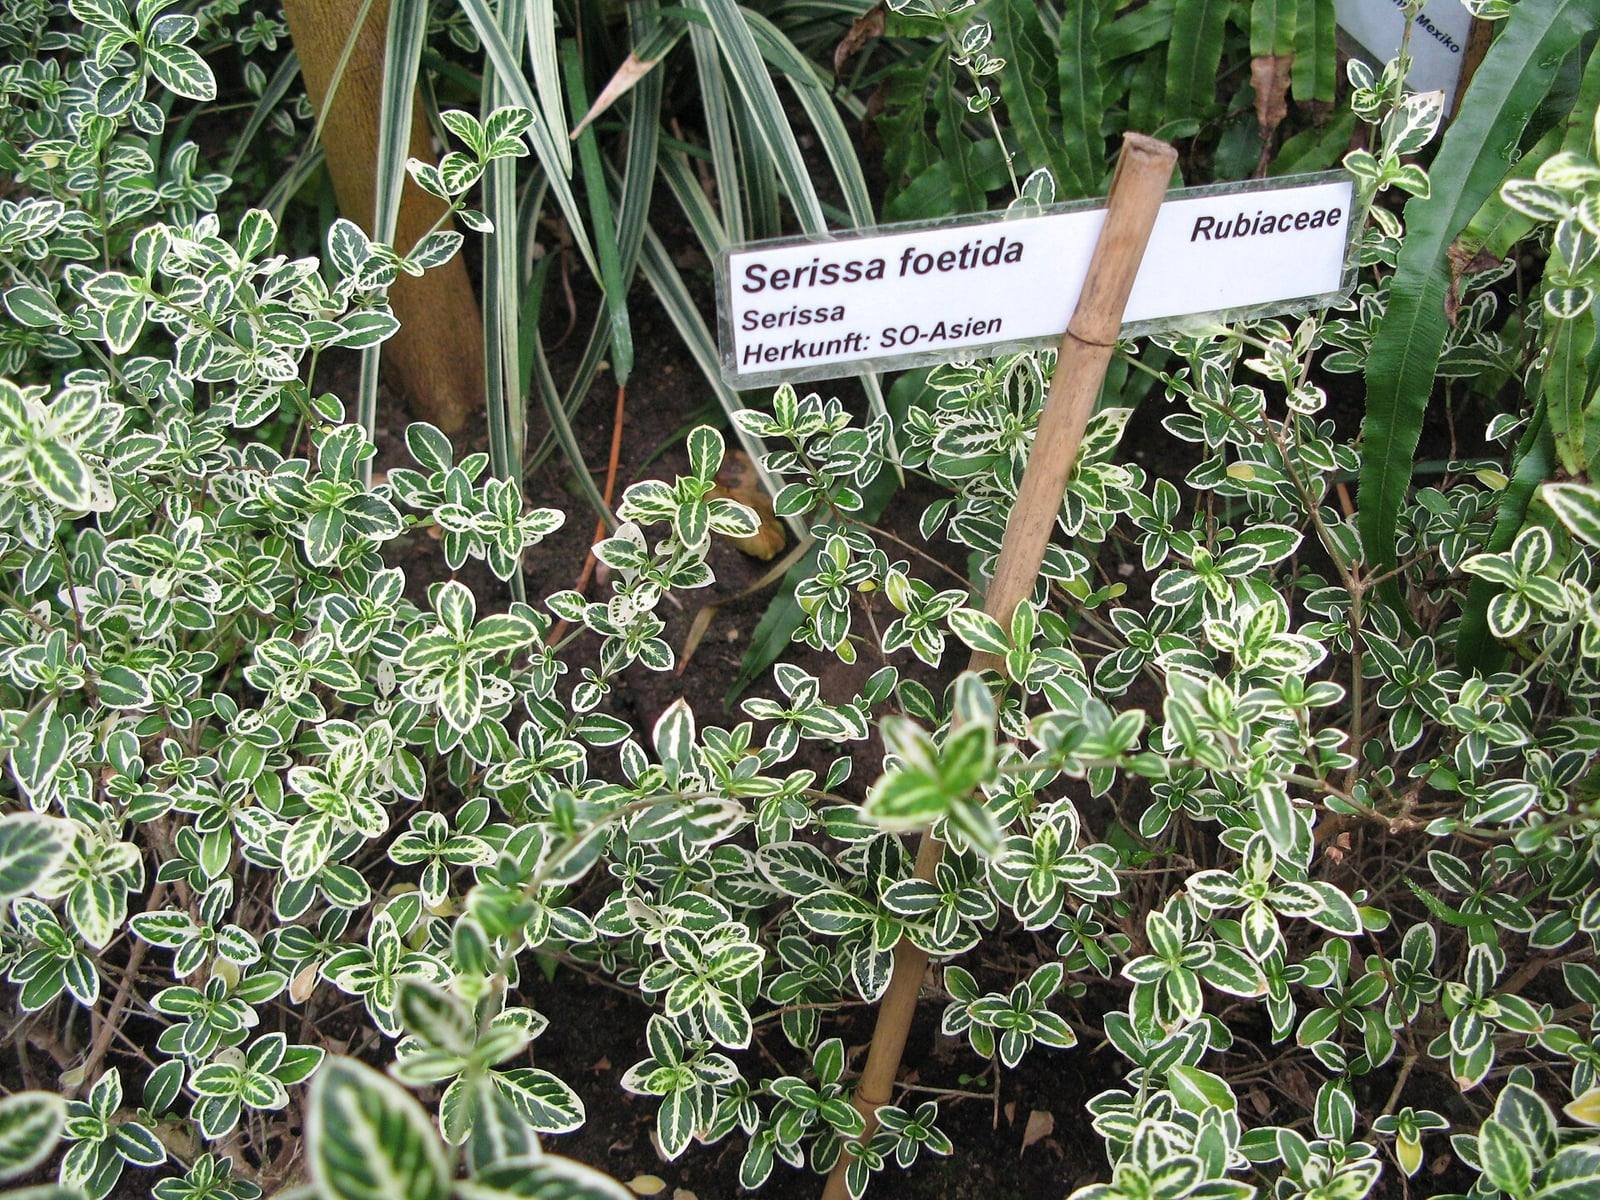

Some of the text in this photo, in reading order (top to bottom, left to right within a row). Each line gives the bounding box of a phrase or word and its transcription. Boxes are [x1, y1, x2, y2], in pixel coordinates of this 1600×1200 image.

[1415, 14, 1460, 53] Mexiko
[1190, 207, 1342, 242] Rubiaceae
[742, 237, 1024, 293] Serissa foetida
[741, 305, 845, 331] Serissa
[743, 317, 1003, 365] Herkunft: SO-Asien
